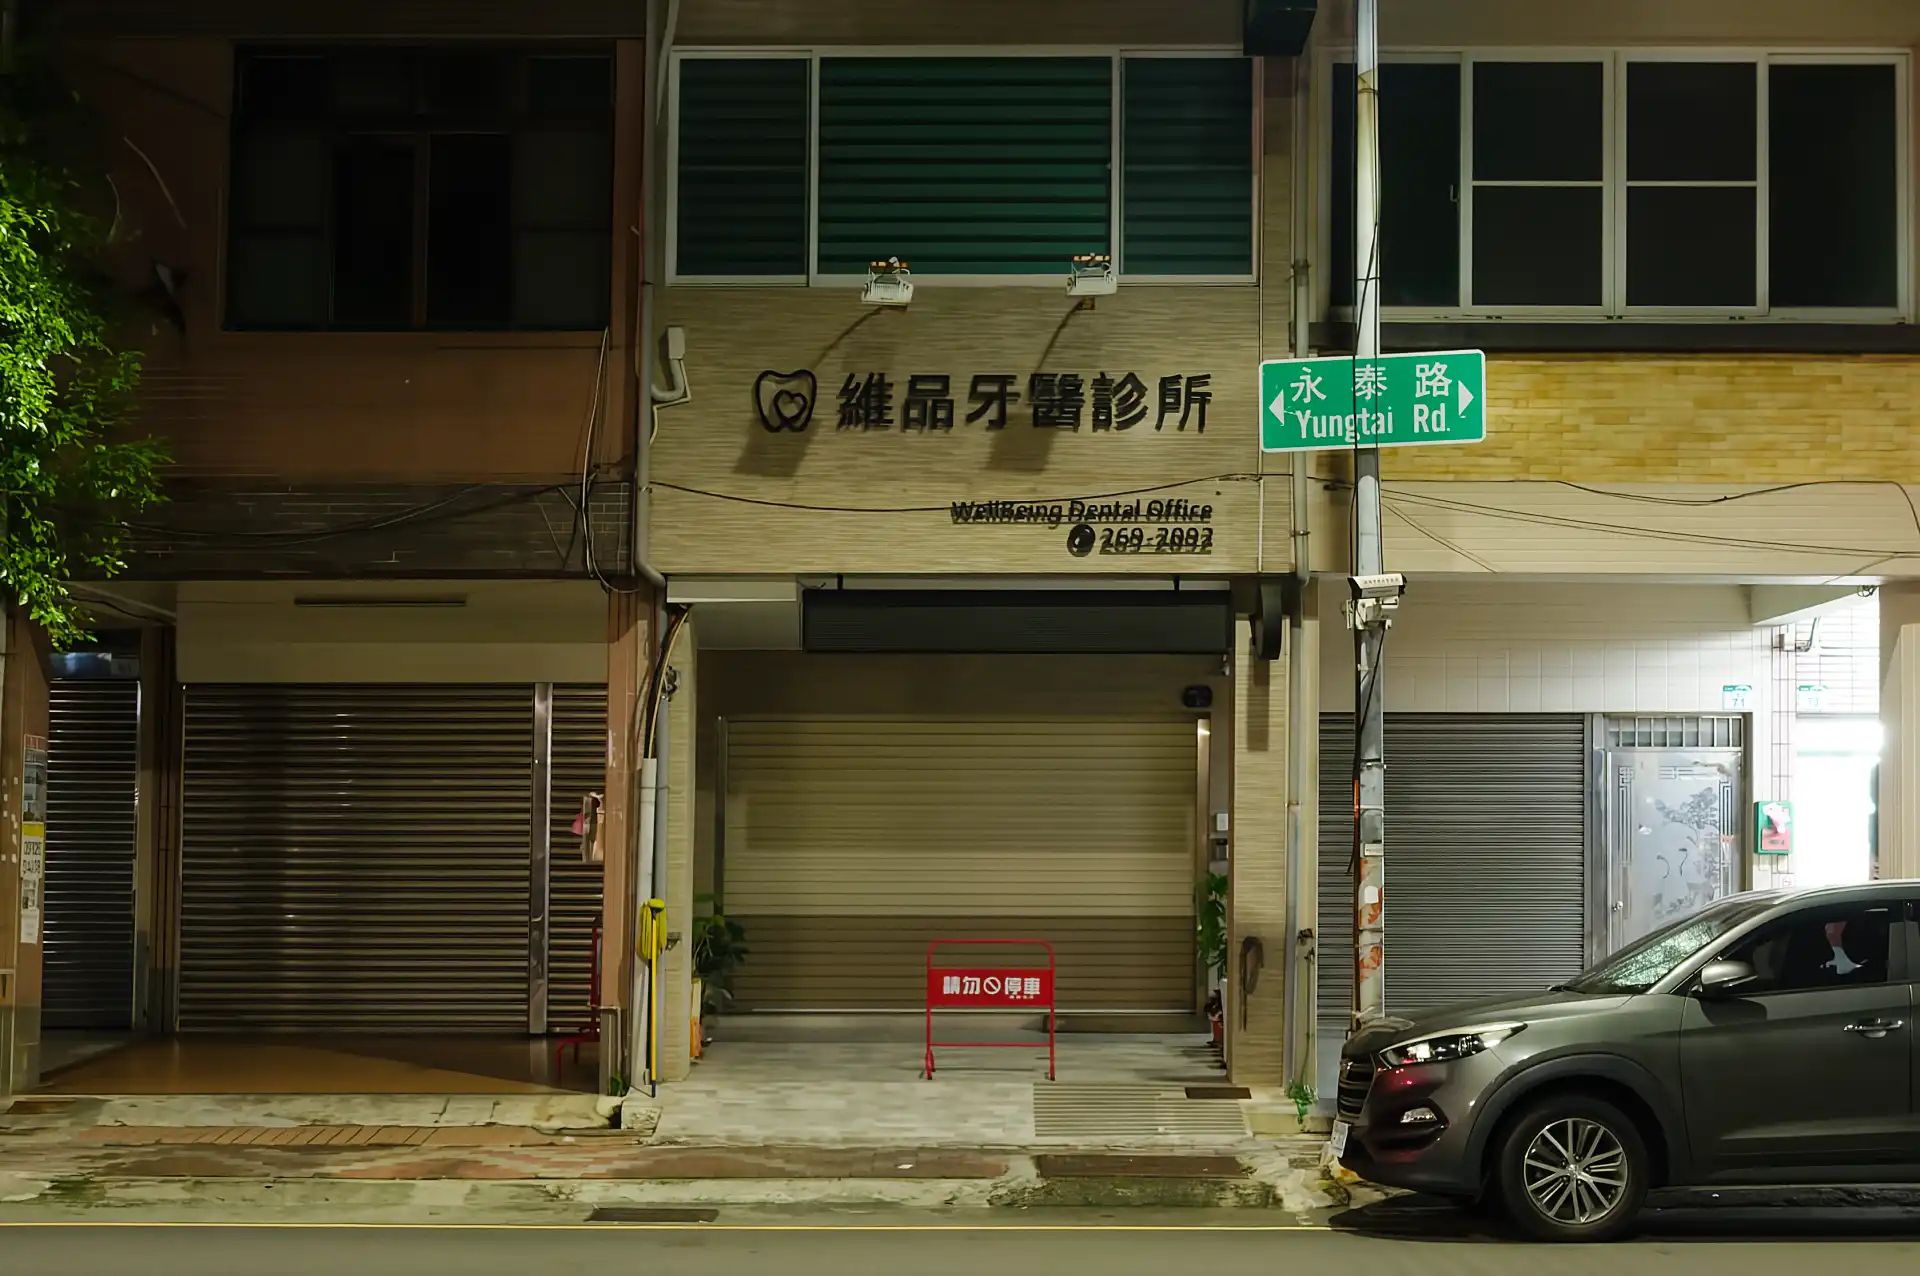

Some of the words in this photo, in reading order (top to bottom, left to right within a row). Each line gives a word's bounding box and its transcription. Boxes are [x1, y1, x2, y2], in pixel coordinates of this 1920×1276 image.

[836, 371, 1213, 434] 維品牙醫診所
[1290, 361, 1453, 404] 永泰路
[1295, 406, 1394, 443] Yungtai
[1413, 402, 1452, 433] Rd.
[951, 500, 1062, 530] WellBeing
[1067, 499, 1141, 524] Dental
[1146, 498, 1213, 524] Office
